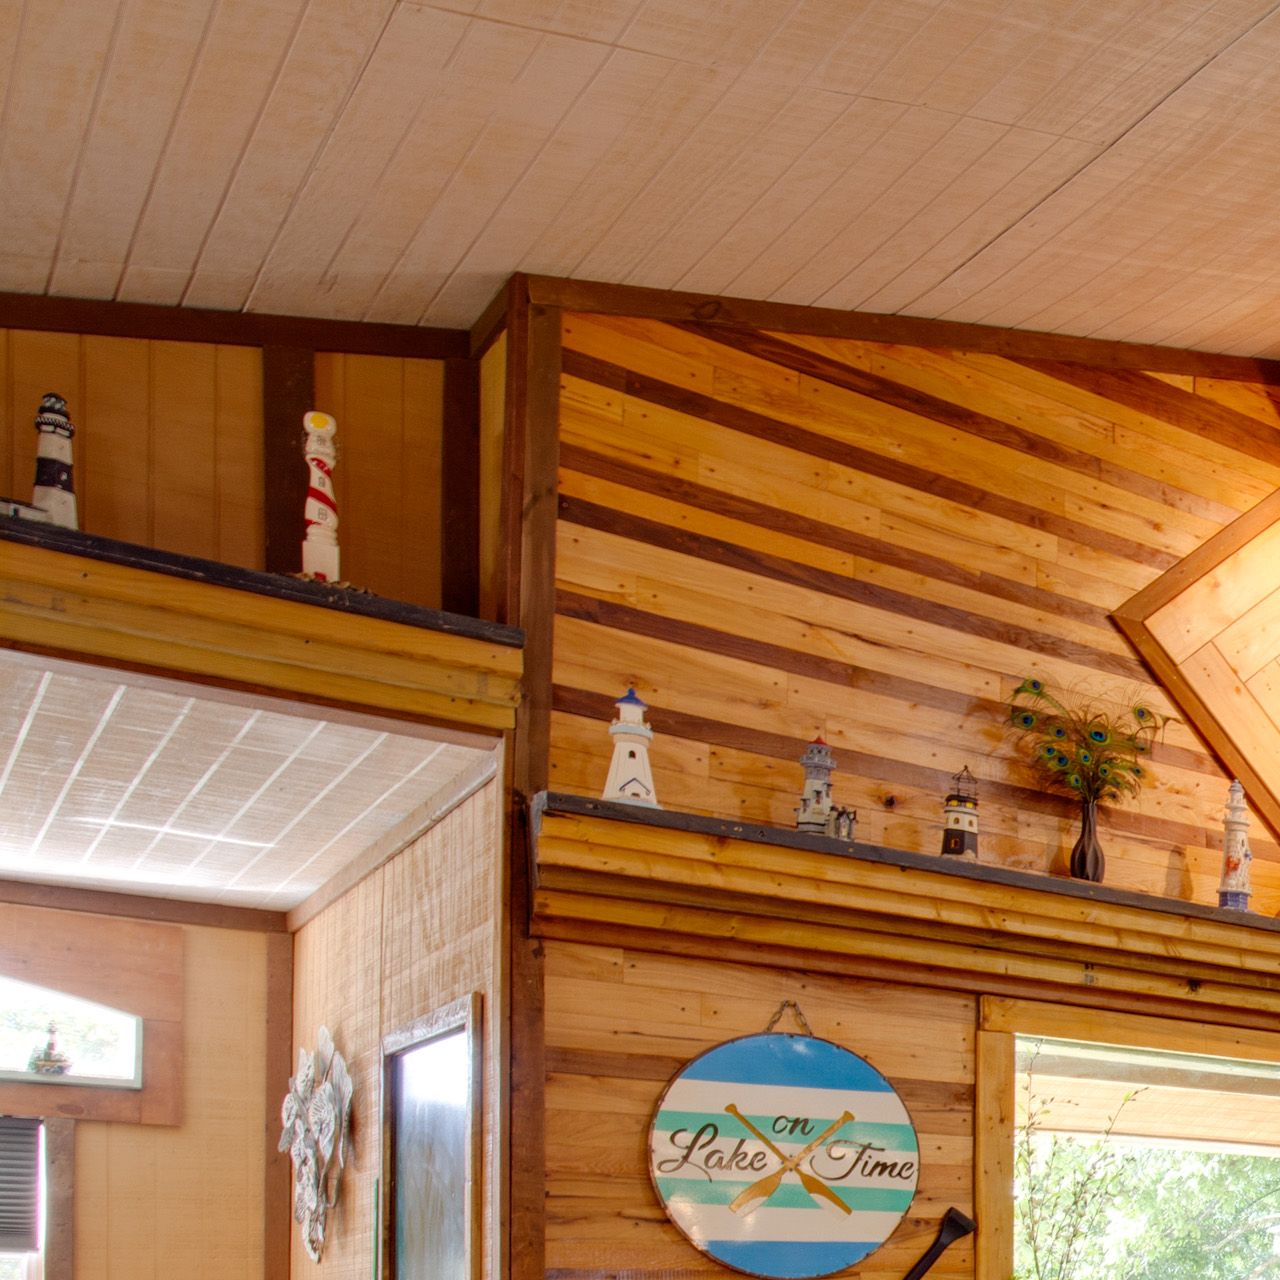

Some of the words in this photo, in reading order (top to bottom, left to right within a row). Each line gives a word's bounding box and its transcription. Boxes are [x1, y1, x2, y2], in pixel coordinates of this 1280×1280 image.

[772, 1114, 815, 1137] on
[657, 1123, 768, 1183] Lake
[809, 1138, 916, 1181] Time
